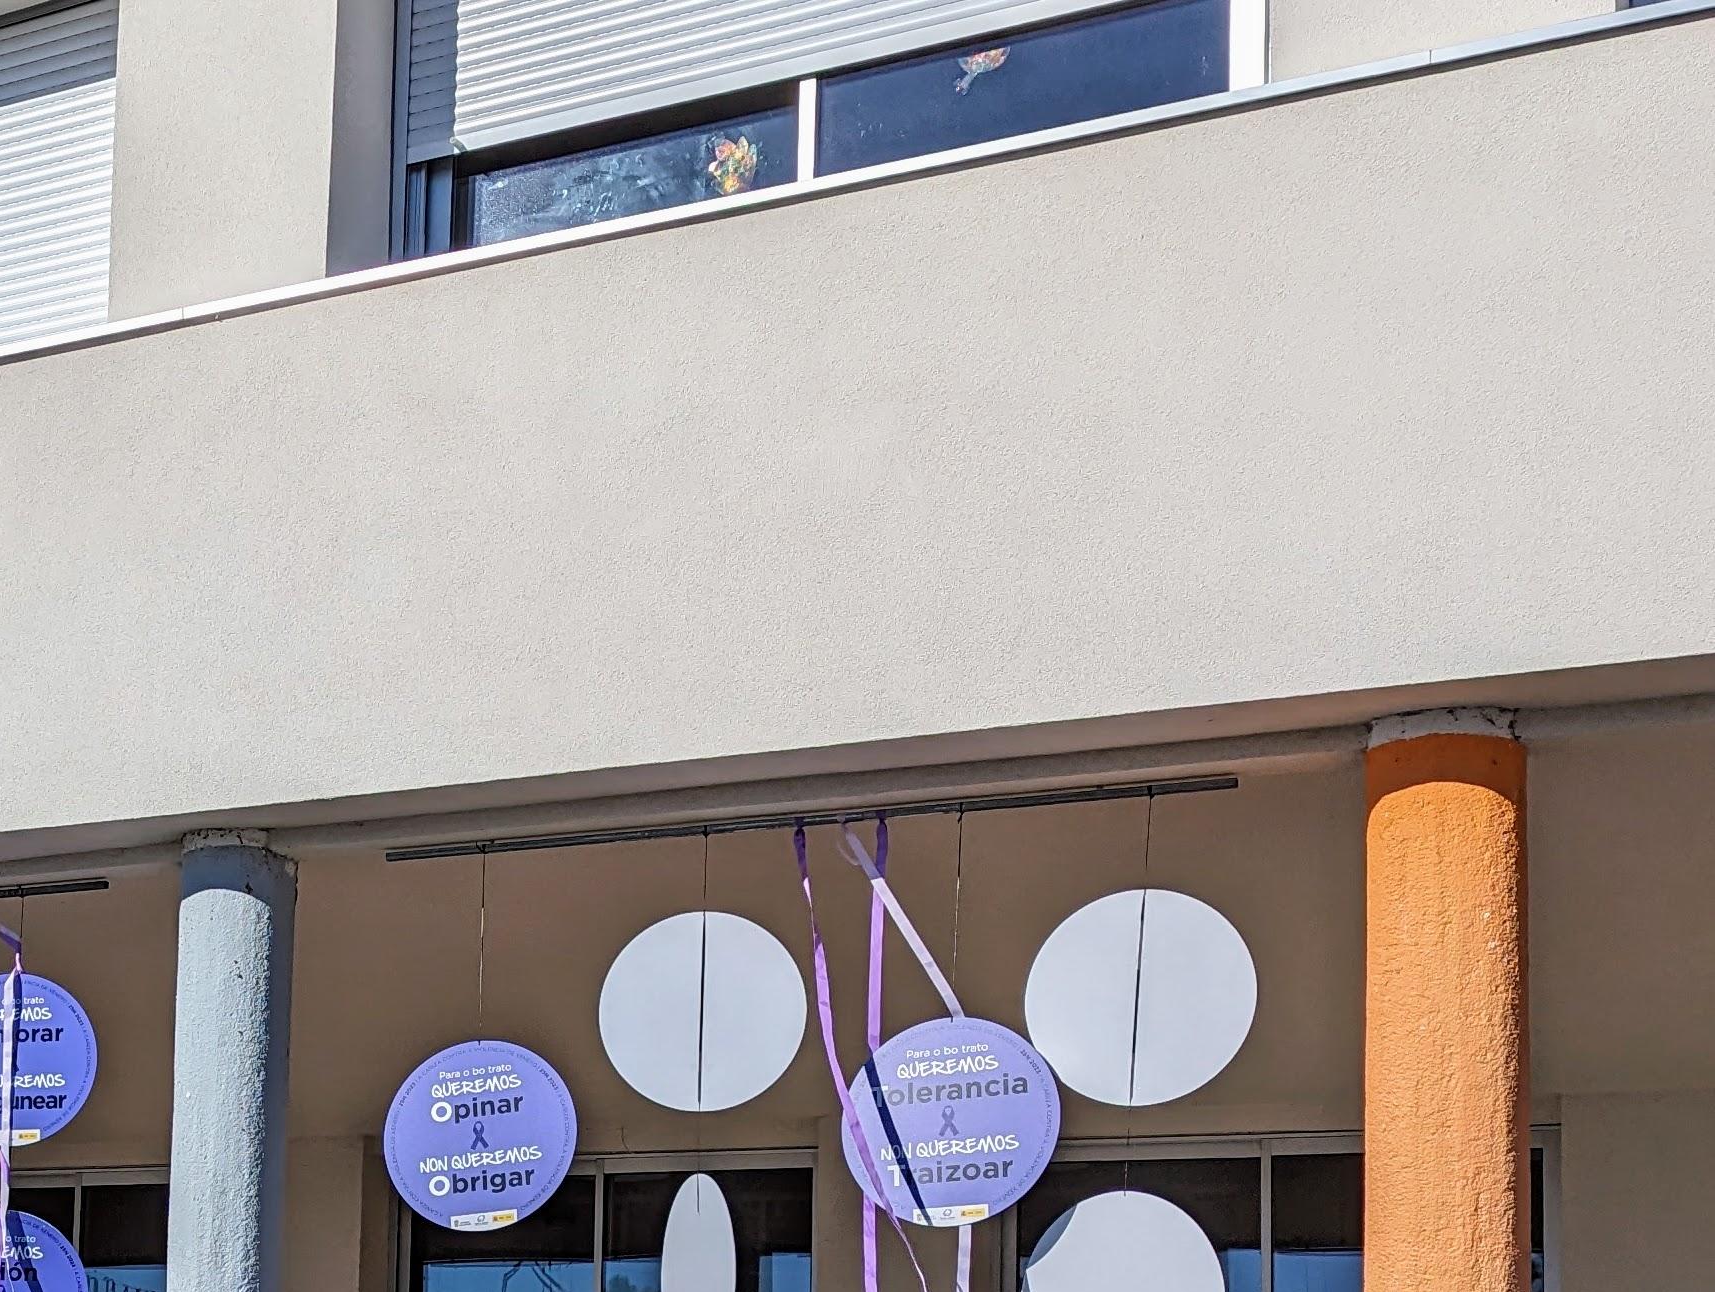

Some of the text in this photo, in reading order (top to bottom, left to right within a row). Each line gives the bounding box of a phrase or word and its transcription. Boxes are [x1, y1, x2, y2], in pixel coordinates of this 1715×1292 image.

[23, 996, 45, 1004] trato
[905, 1042, 989, 1060] Para o bo trato
[439, 1070, 461, 1080] Para
[473, 1066, 485, 1076] bo
[488, 1064, 511, 1073] trato
[897, 1055, 999, 1079] QUEREMOS
[431, 1074, 521, 1098] QUEREMOS
[871, 1073, 1029, 1108] Tolerancia
[431, 1096, 523, 1124] Opinar
[881, 1134, 1019, 1160] NON QUEREMOS
[419, 1156, 447, 1174] NON
[451, 1146, 543, 1168] QUEREMOS
[429, 1168, 535, 1196] Obrigar
